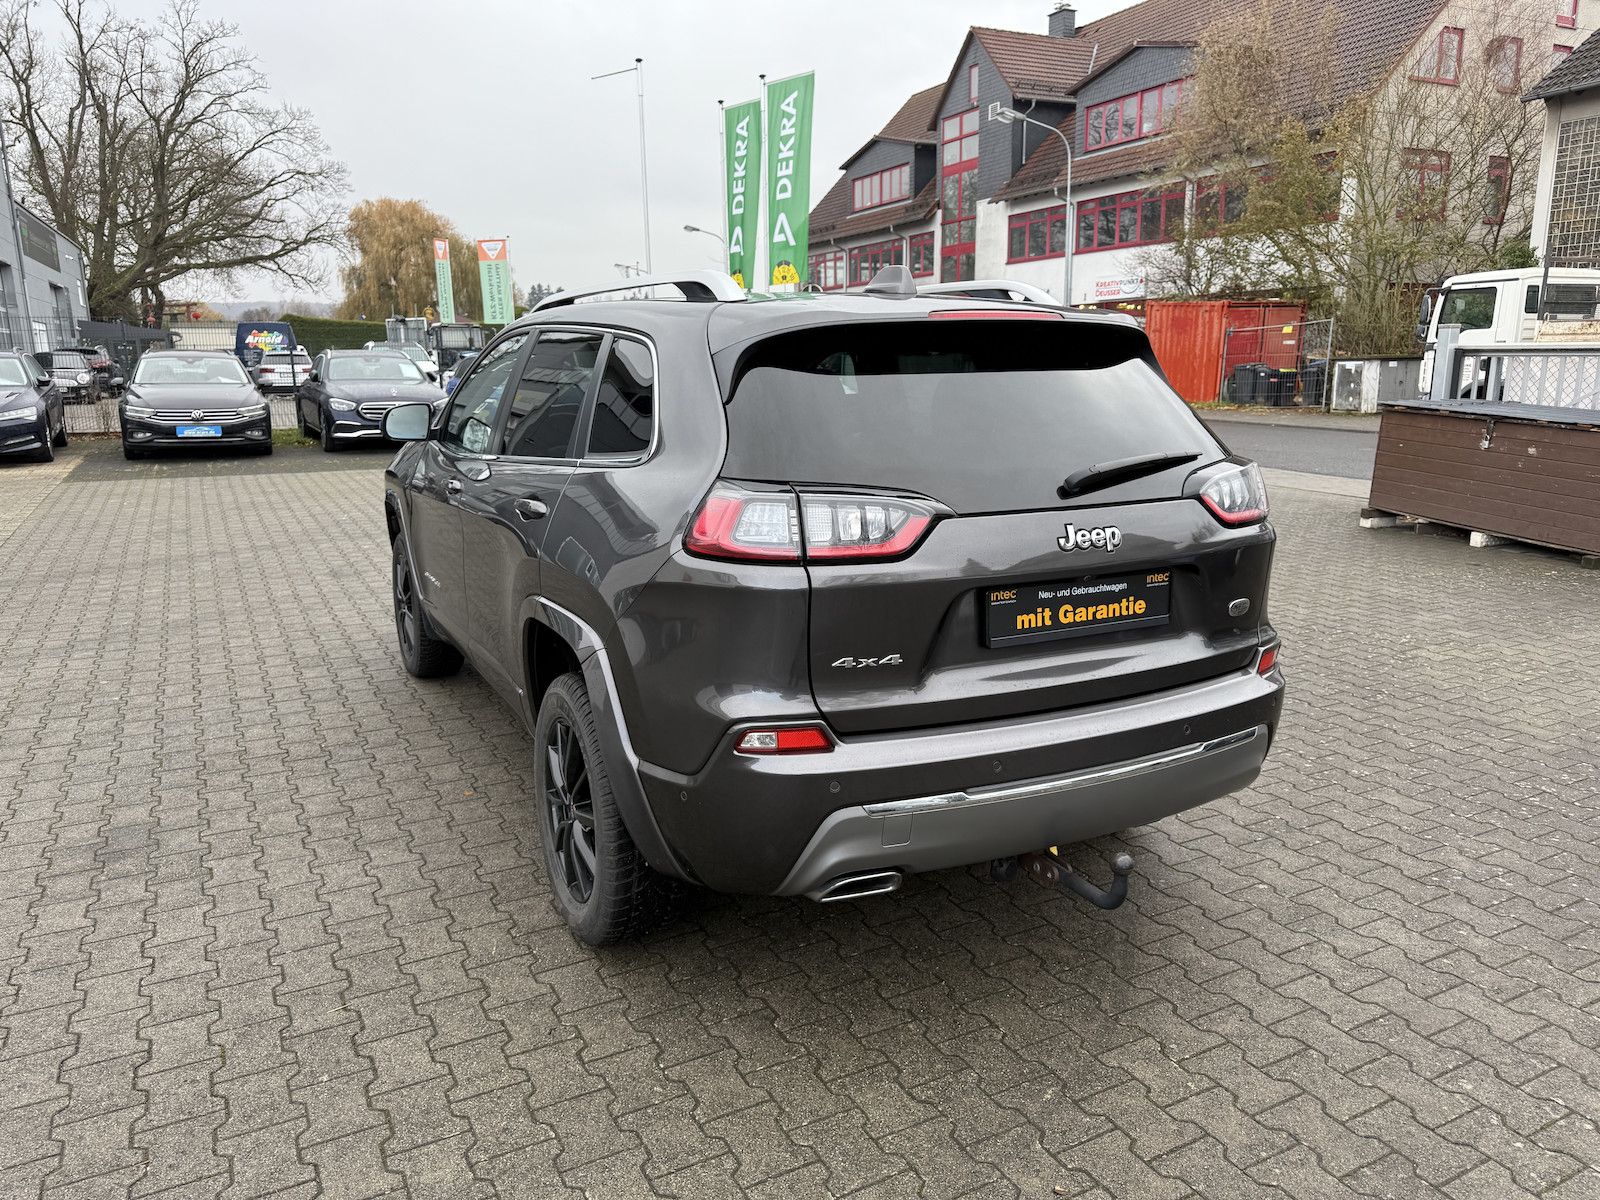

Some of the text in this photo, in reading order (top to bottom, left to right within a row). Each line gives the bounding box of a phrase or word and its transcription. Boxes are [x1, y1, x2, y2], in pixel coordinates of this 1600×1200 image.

[775, 90, 799, 201] DEKRA
[732, 115, 750, 215] DEKRA
[245, 334, 283, 344] Arnold
[1057, 523, 1122, 553] Jeep
[1146, 572, 1170, 584] intec
[990, 590, 1017, 602] intec
[1038, 582, 1128, 600] Neu- und Gebrauchtwagen
[1016, 596, 1147, 630] mit Garantie
[831, 654, 904, 669] 4x4
